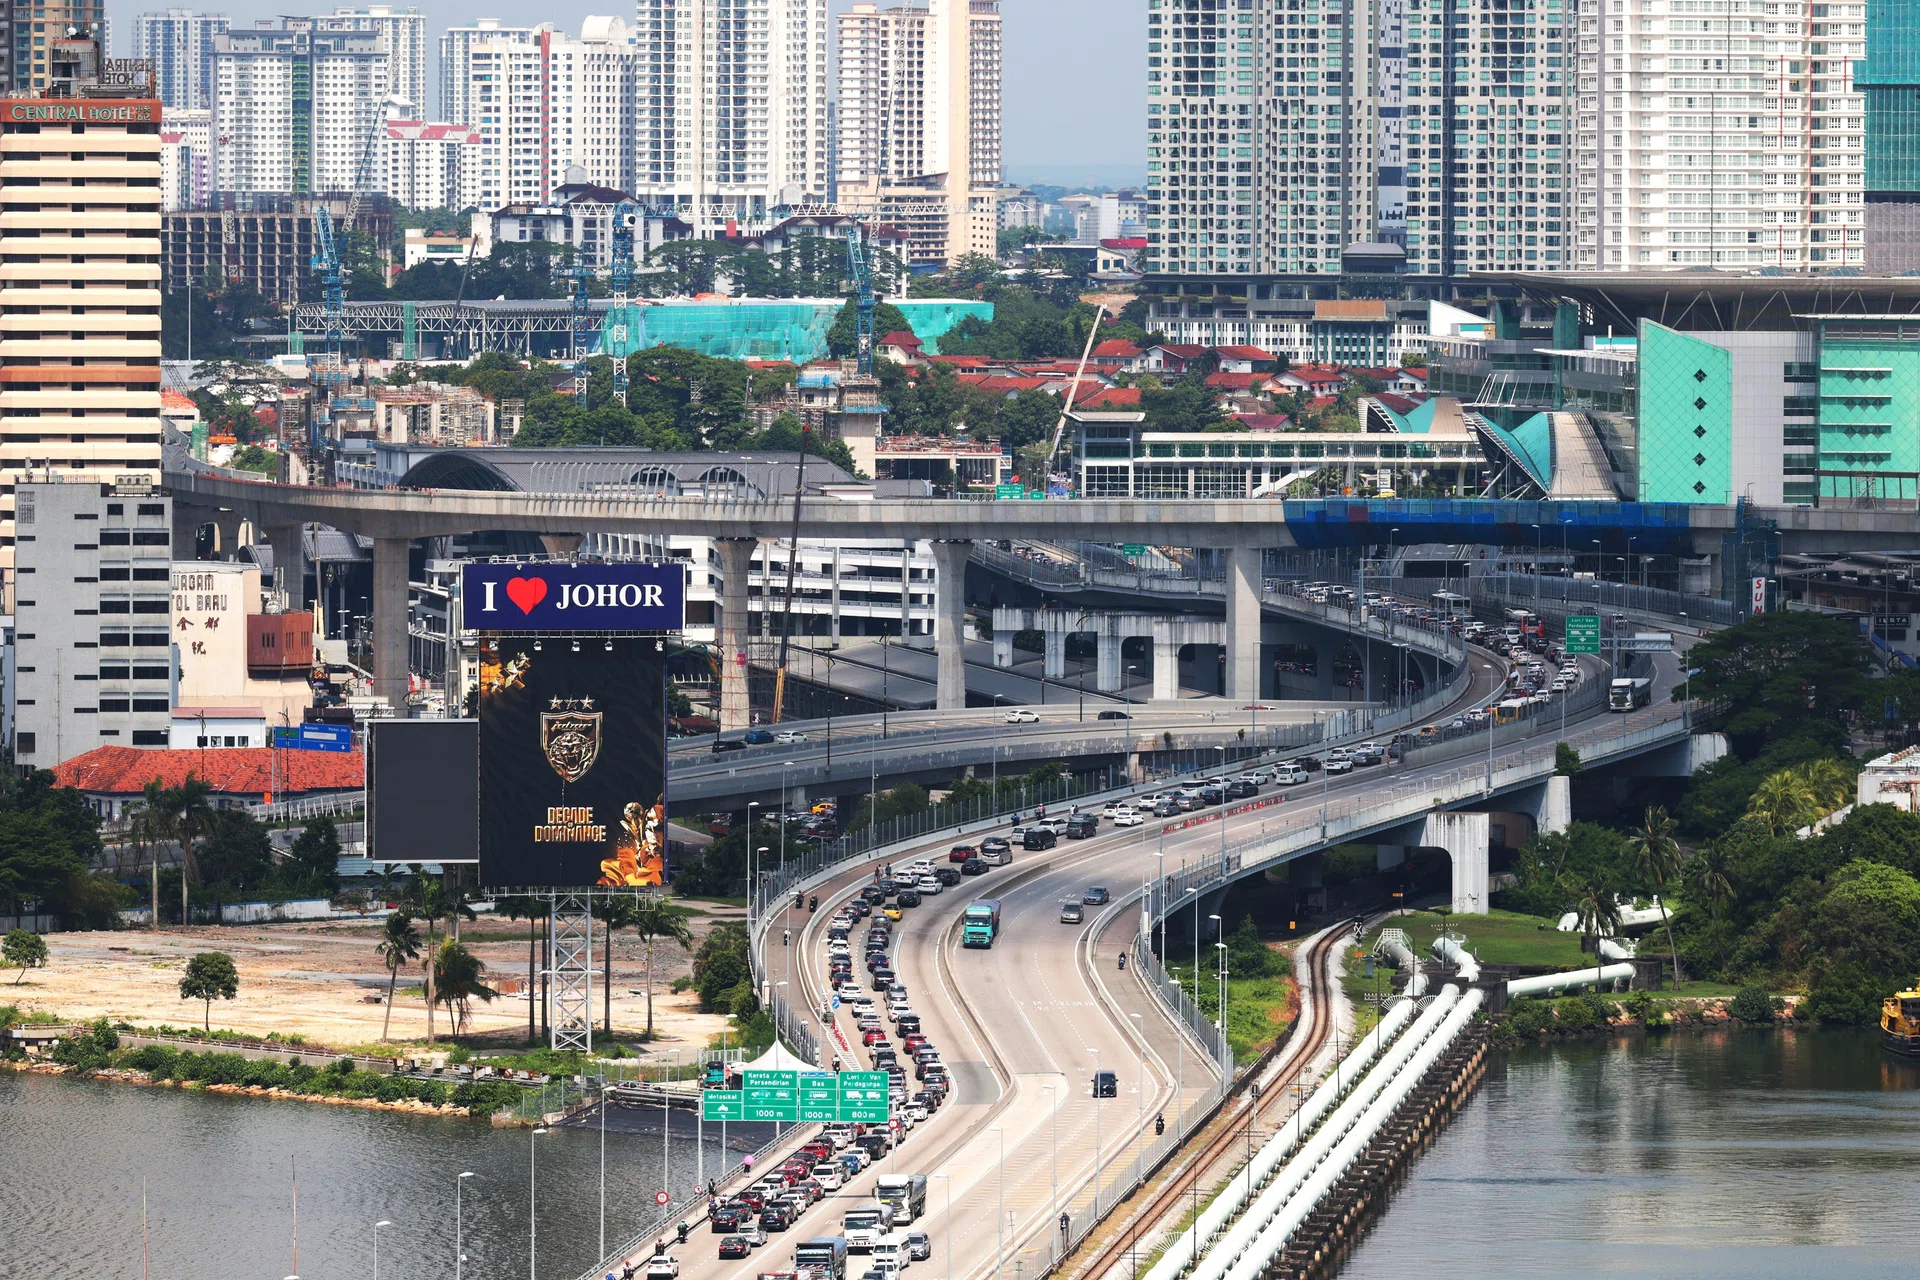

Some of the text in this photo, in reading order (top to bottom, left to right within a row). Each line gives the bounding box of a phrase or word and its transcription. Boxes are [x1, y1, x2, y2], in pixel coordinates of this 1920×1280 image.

[11, 105, 134, 120] CENTRAL HOTEL
[172, 595, 227, 611] OL BARU
[482, 582, 665, 611] I JOHOR
[547, 807, 594, 824] DECADE
[534, 825, 607, 842] DOMINANCE
